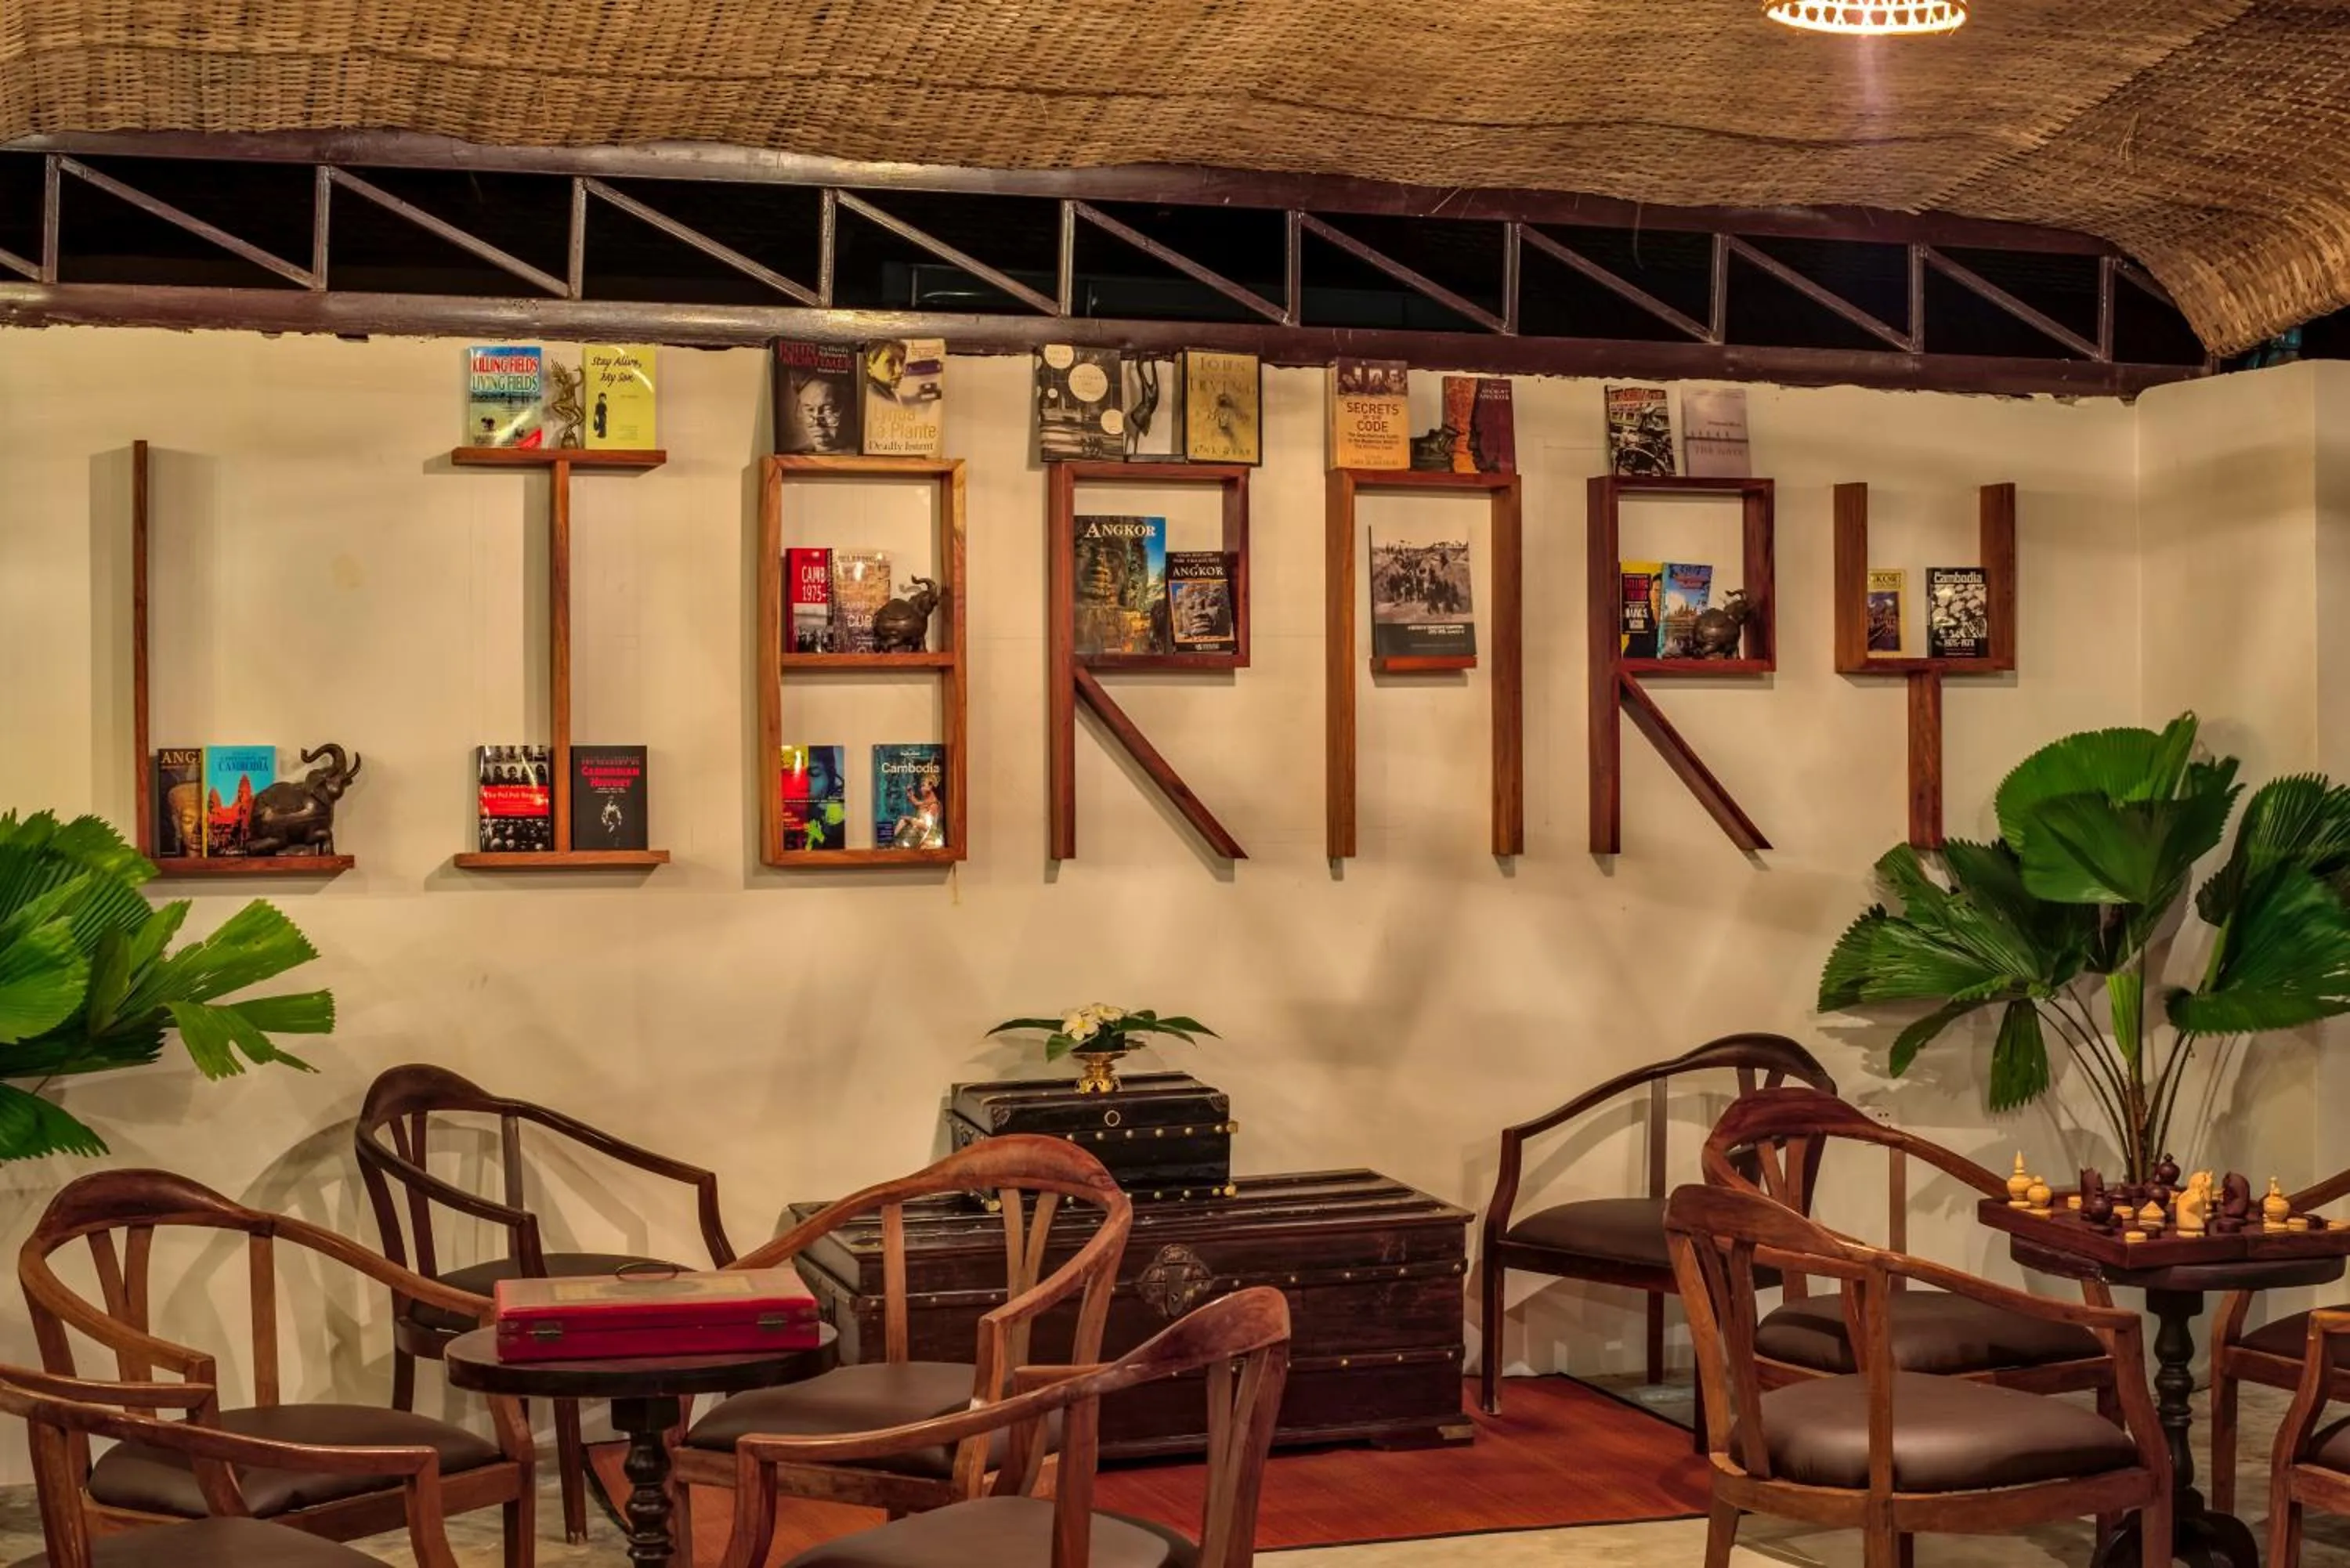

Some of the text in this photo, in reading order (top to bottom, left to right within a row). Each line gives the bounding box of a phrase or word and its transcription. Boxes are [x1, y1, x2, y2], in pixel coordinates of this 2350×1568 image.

[472, 356, 538, 373] KILLING FIELDS
[591, 356, 642, 372] Stay Alive,
[472, 374, 538, 392] LIVING FIELDS
[600, 372, 634, 388] My Son
[872, 406, 916, 423] Lynda
[1346, 402, 1399, 416] SECRETS
[868, 423, 937, 439] La Plante
[1356, 421, 1389, 432] CODE
[868, 440, 902, 453] Deadly
[1084, 522, 1156, 538] ANGKOR
[1173, 566, 1224, 577] ANGKOR
[1933, 571, 1983, 583] Cambodia
[802, 584, 827, 602] 1975-
[847, 614, 873, 627] CUR
[134, 440, 2015, 870] LIBRARY
[218, 760, 269, 771] CAMBODIA
[580, 767, 640, 776] CAMBODIAN
[881, 762, 940, 774] Cambodia
